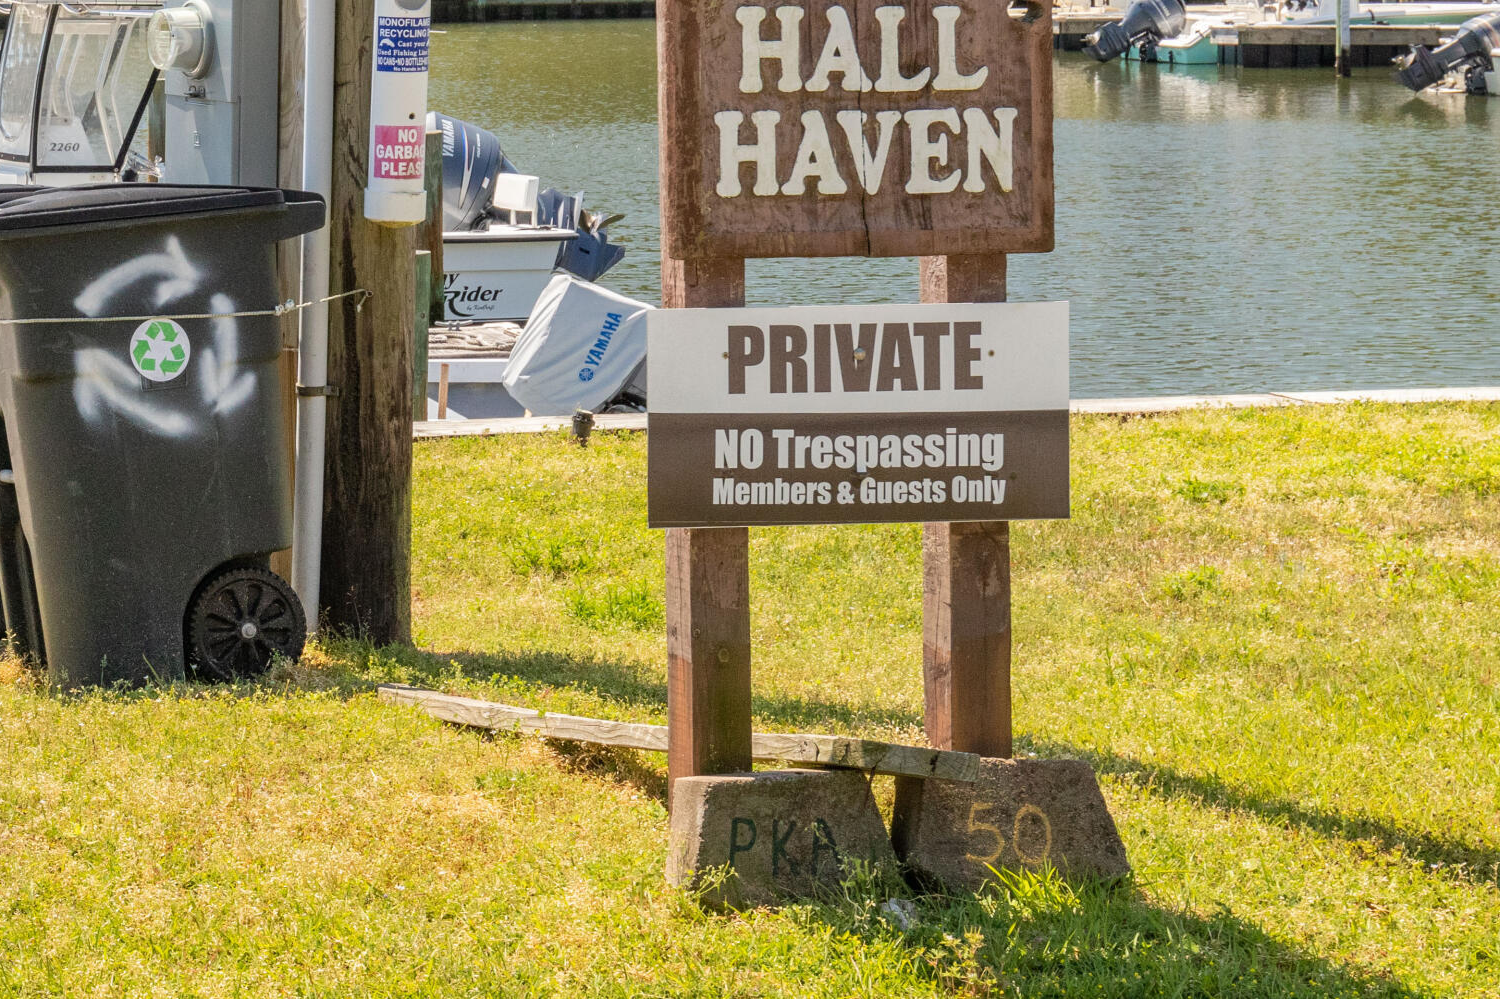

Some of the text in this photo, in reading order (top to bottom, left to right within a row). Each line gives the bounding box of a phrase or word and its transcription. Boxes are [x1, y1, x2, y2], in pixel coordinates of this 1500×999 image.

[379, 28, 427, 38] RECYCLING
[393, 49, 418, 58] Fishing
[735, 4, 989, 94] HALL
[49, 142, 80, 152] 2260
[397, 128, 418, 143] NO
[442, 119, 455, 157] YAMAHA
[713, 107, 1018, 199] HAVEN
[443, 286, 504, 317] Rider
[584, 311, 623, 367] YAMAHA
[727, 320, 984, 395] PRIVATE
[714, 427, 1005, 473] NO Trespassing
[712, 475, 1007, 505] Members & Guests Only
[729, 816, 842, 879] PKA
[965, 801, 1053, 865] 50
